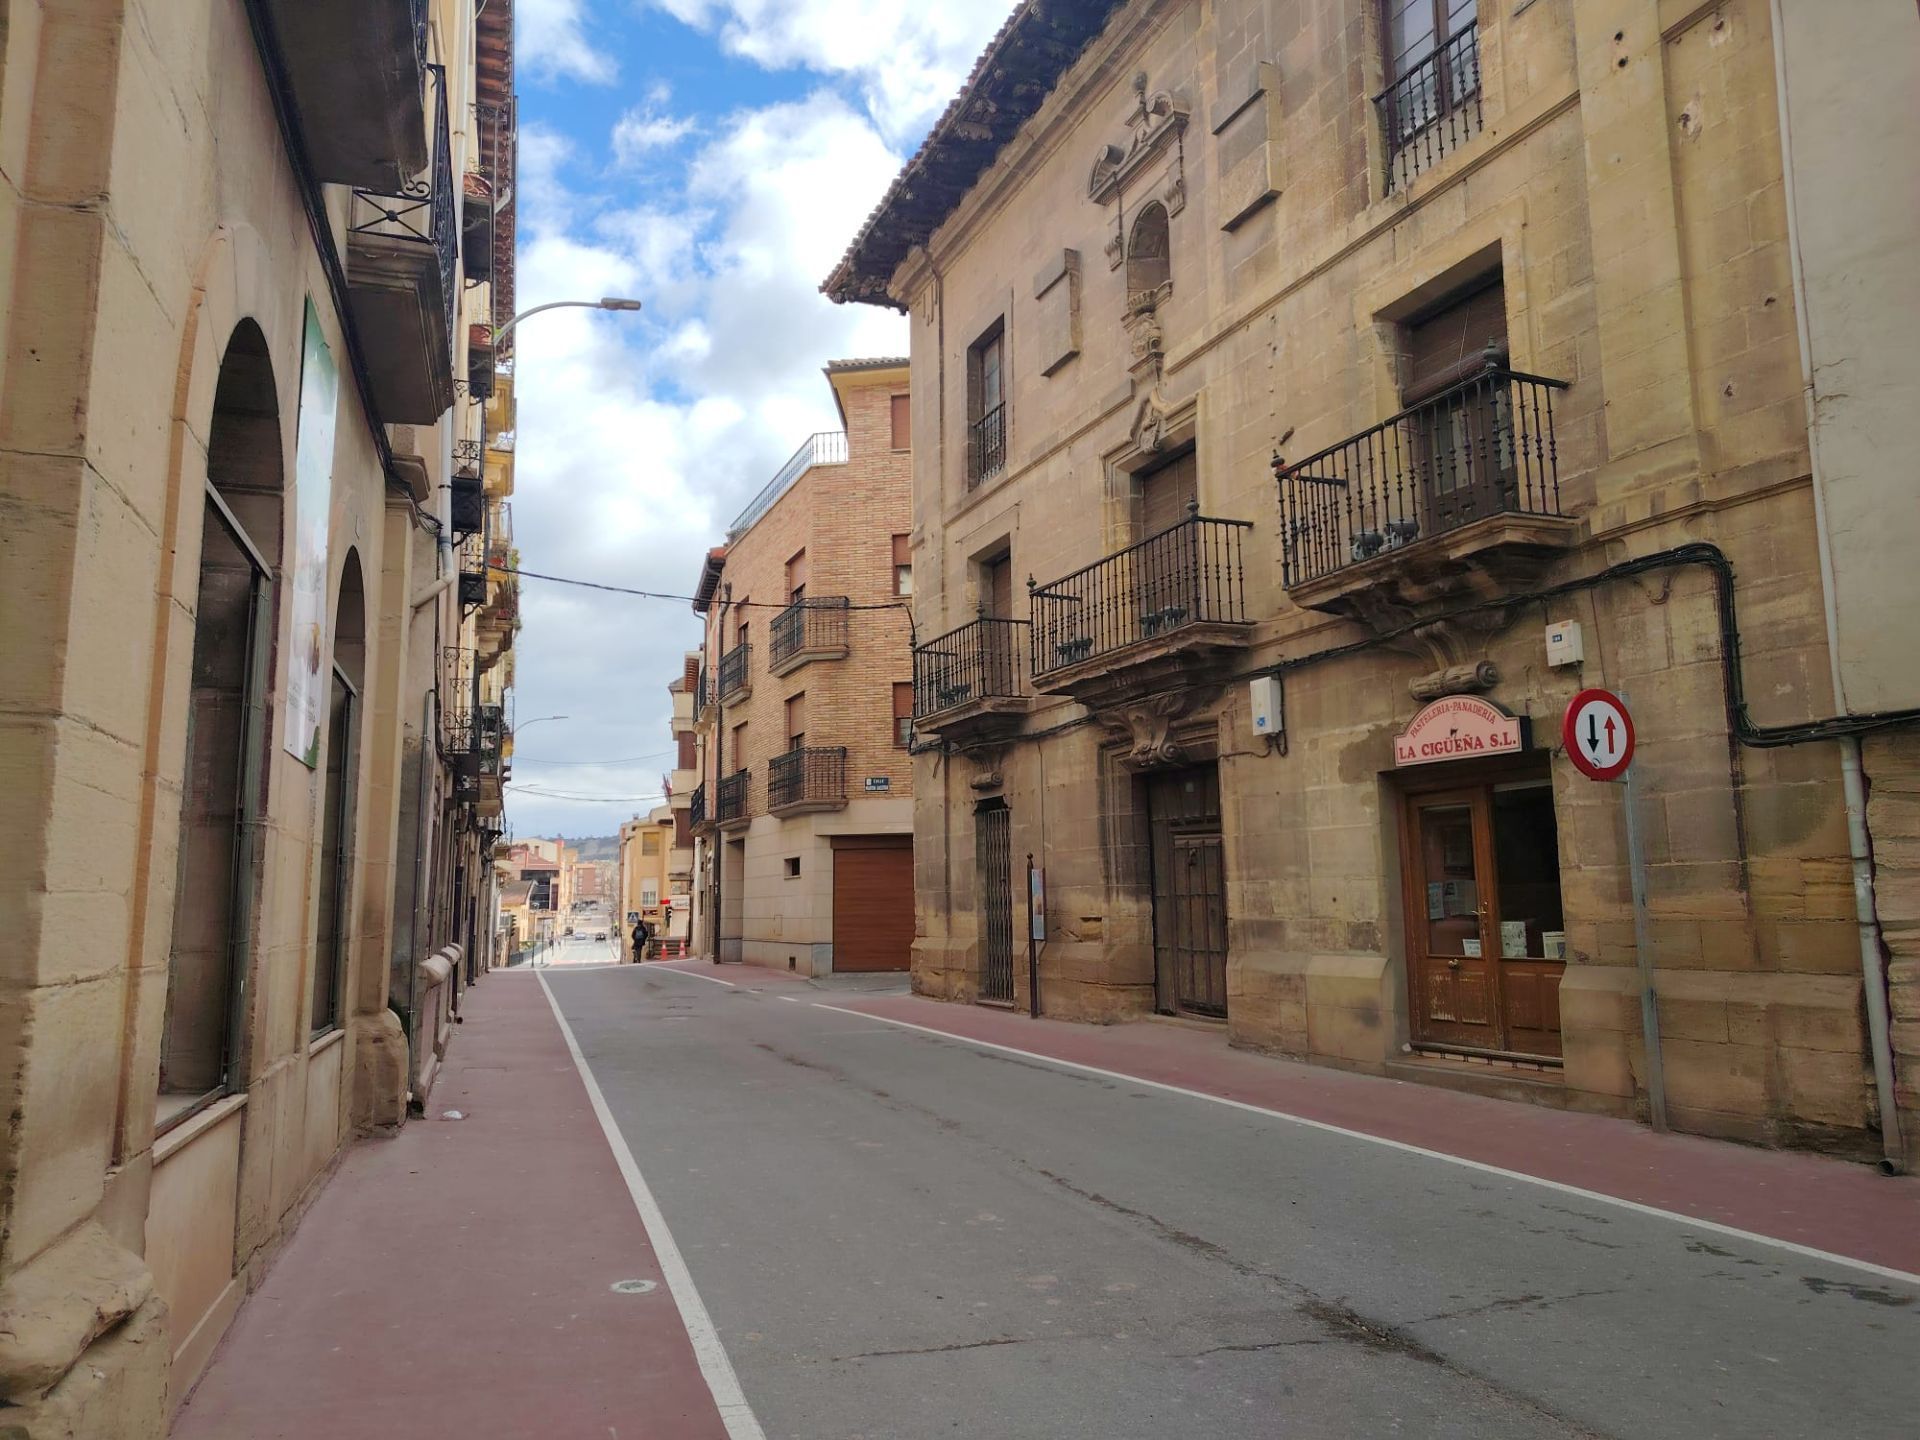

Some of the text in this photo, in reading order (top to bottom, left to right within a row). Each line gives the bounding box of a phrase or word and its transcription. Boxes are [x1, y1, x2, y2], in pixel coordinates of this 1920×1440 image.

[1399, 731, 1517, 760] LA CIGÜEÑA S.L.
